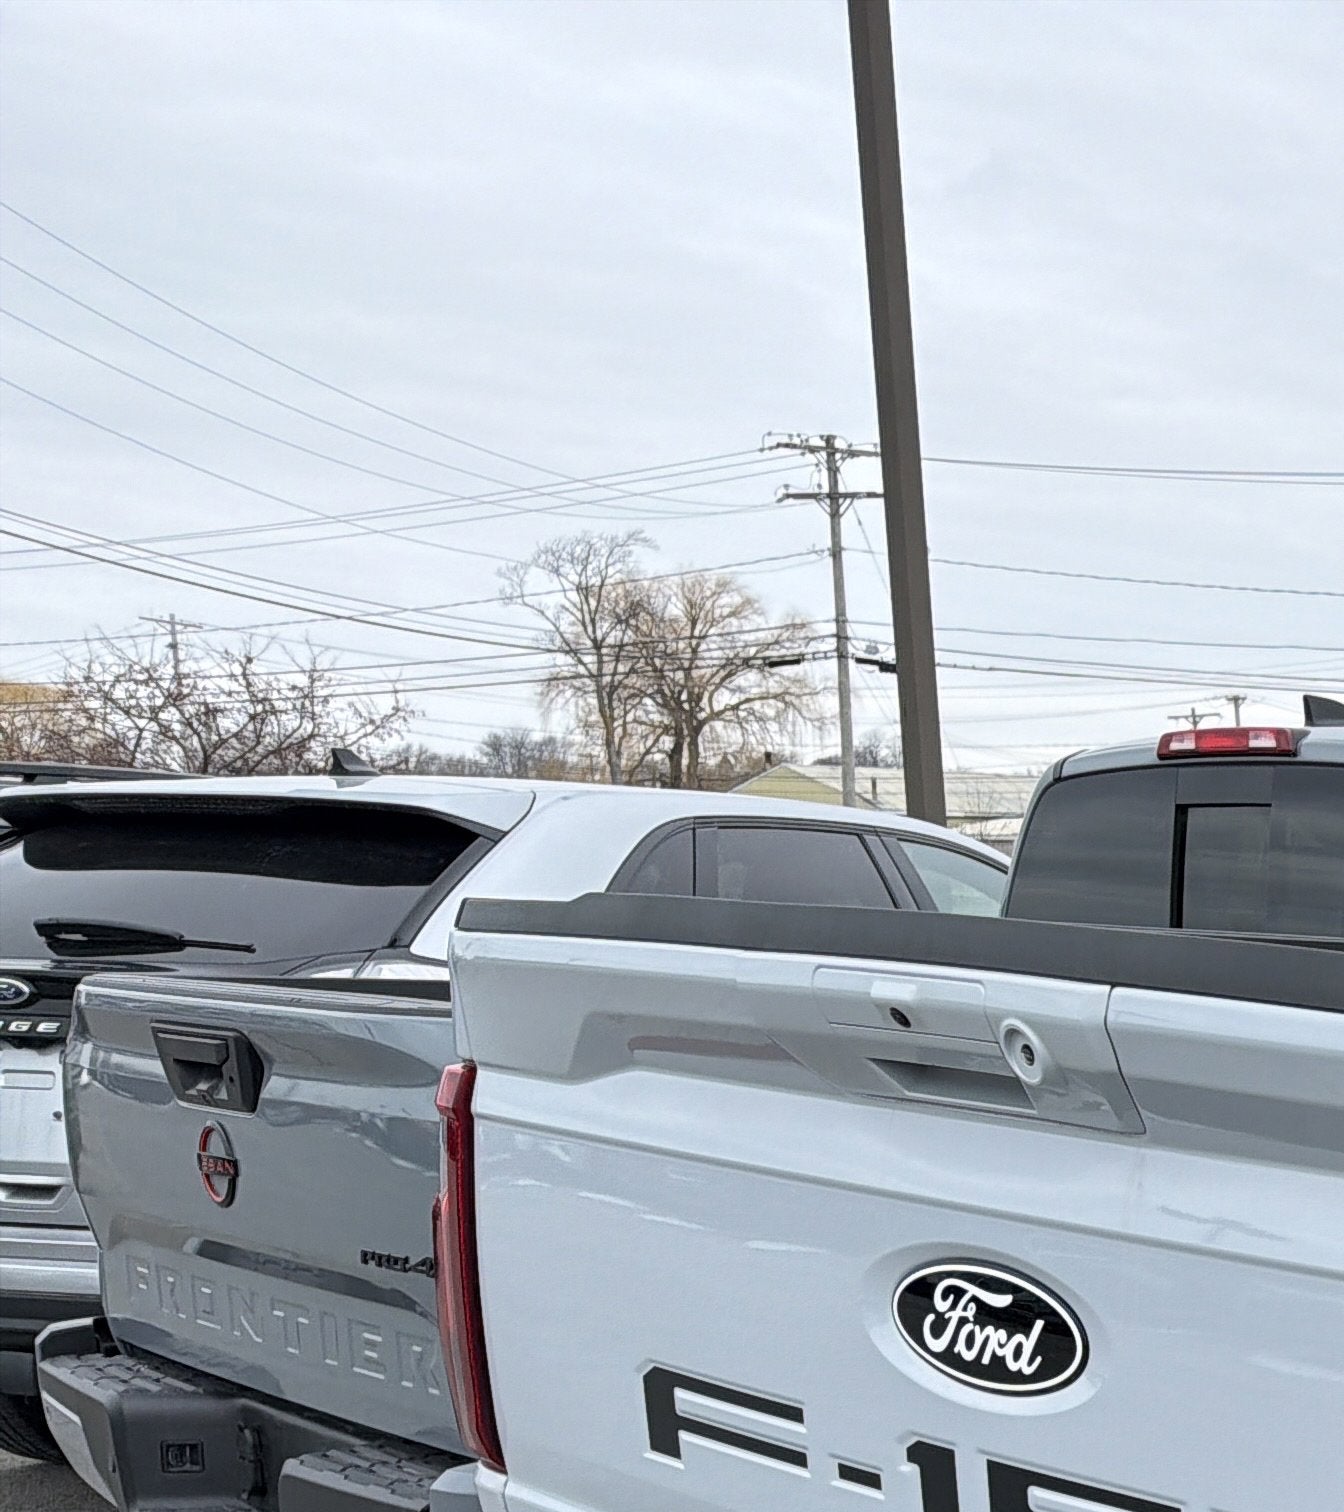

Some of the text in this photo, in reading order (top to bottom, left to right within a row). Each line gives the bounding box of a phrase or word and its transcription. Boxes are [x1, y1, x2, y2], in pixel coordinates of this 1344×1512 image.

[0, 1020, 61, 1033] GE
[197, 1153, 238, 1177] SSAN
[125, 1254, 441, 1396] FRONTIER
[923, 1277, 1045, 1375] Ford
